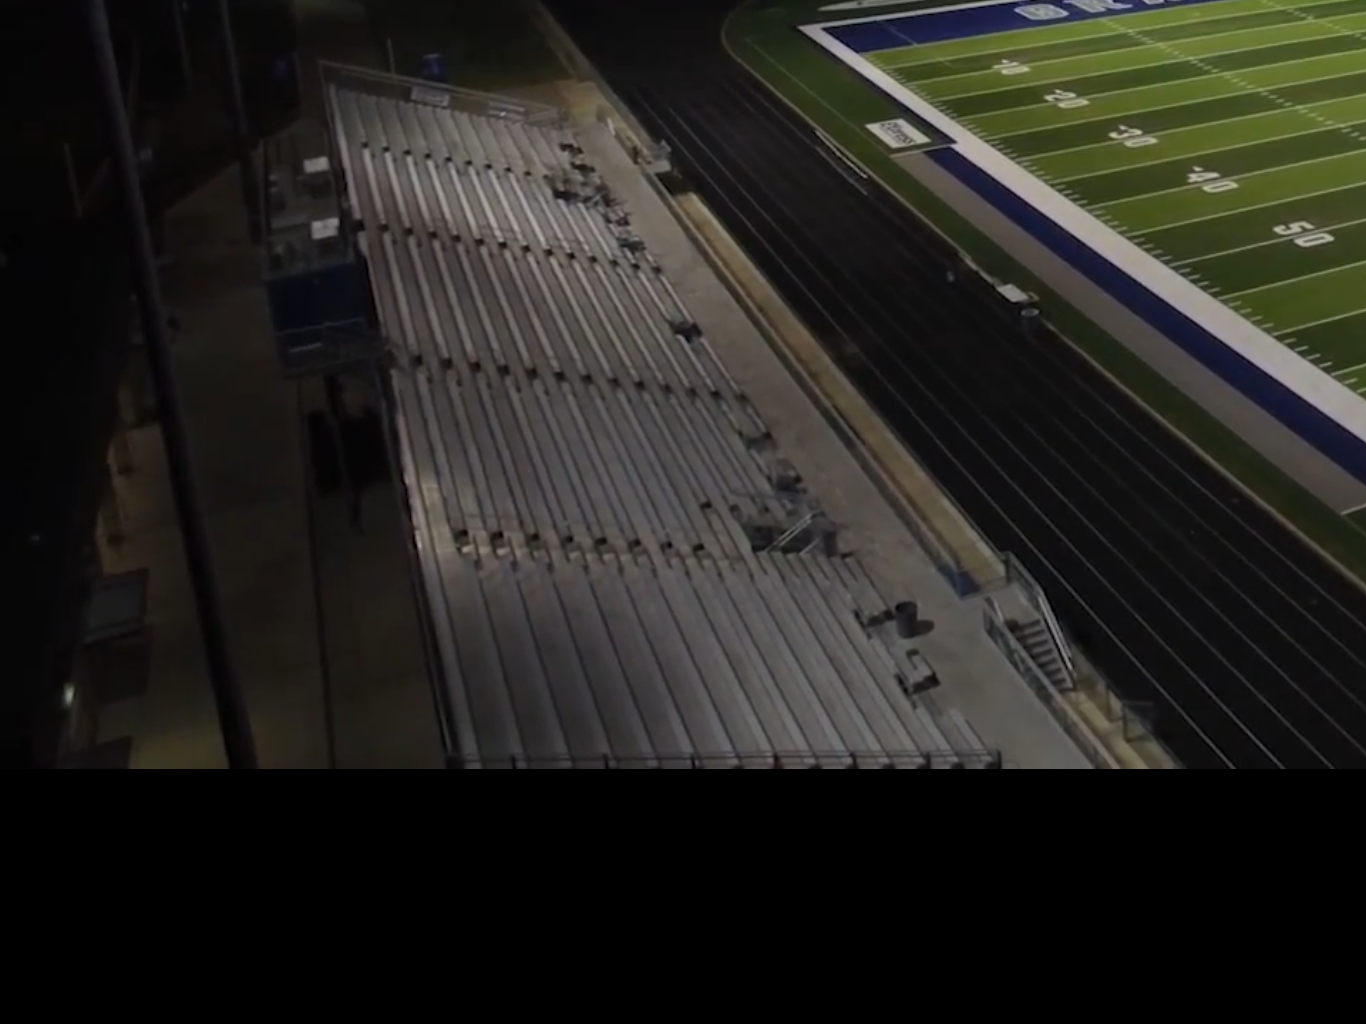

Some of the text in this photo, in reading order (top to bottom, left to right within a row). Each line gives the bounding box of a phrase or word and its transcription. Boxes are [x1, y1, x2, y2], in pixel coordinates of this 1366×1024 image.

[1043, 90, 1089, 108] 20
[1108, 127, 1158, 147] 30
[1187, 171, 1239, 193] 40
[1272, 221, 1335, 247] 50
